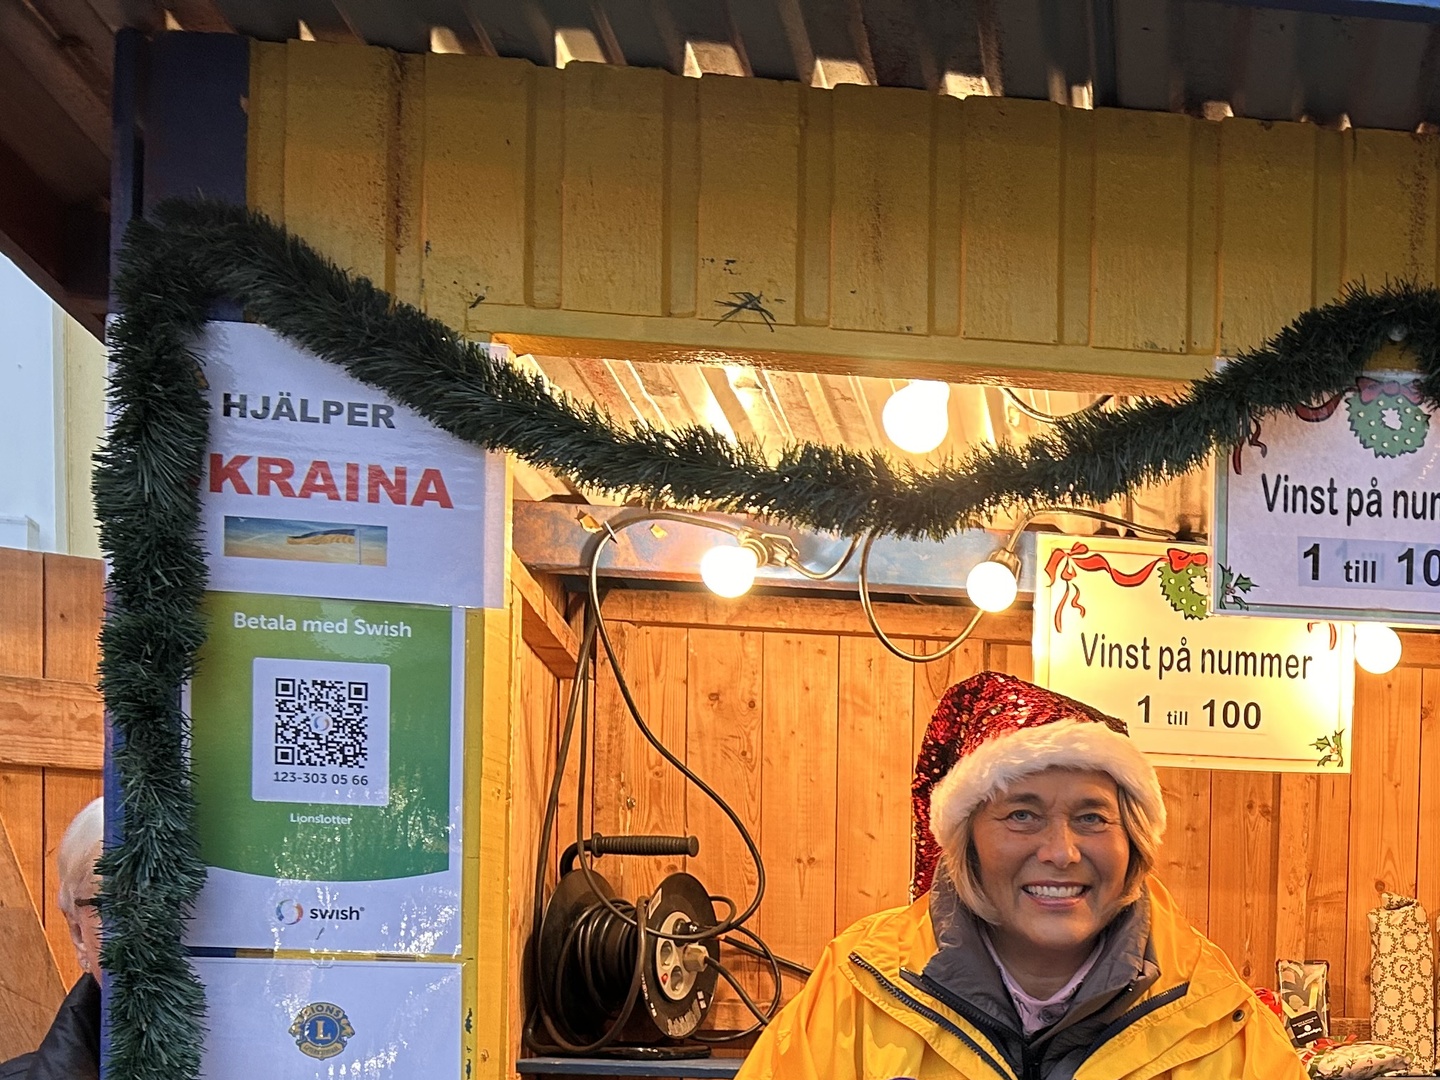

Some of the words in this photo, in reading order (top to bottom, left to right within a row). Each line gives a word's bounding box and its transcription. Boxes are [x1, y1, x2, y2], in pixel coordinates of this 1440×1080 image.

[223, 391, 396, 429] HJÄLPER
[208, 452, 455, 510] KRAINA
[1260, 473, 1338, 517] Vinst
[1346, 479, 1383, 527] på
[1302, 543, 1321, 582] 1
[1343, 559, 1378, 584] till
[233, 612, 297, 631] Betala
[302, 614, 348, 635] med
[354, 618, 412, 638] Swish
[1080, 631, 1151, 670] Vinst
[1158, 637, 1192, 680] på
[1200, 647, 1313, 681] nummer
[1136, 695, 1153, 724] 1
[1166, 709, 1189, 727] till
[1201, 698, 1262, 731] 100
[273, 771, 328, 785] 123-303
[330, 773, 348, 786] 05
[351, 774, 369, 787] 66
[290, 812, 353, 826] Lionslotter
[315, 1020, 332, 1040] L
